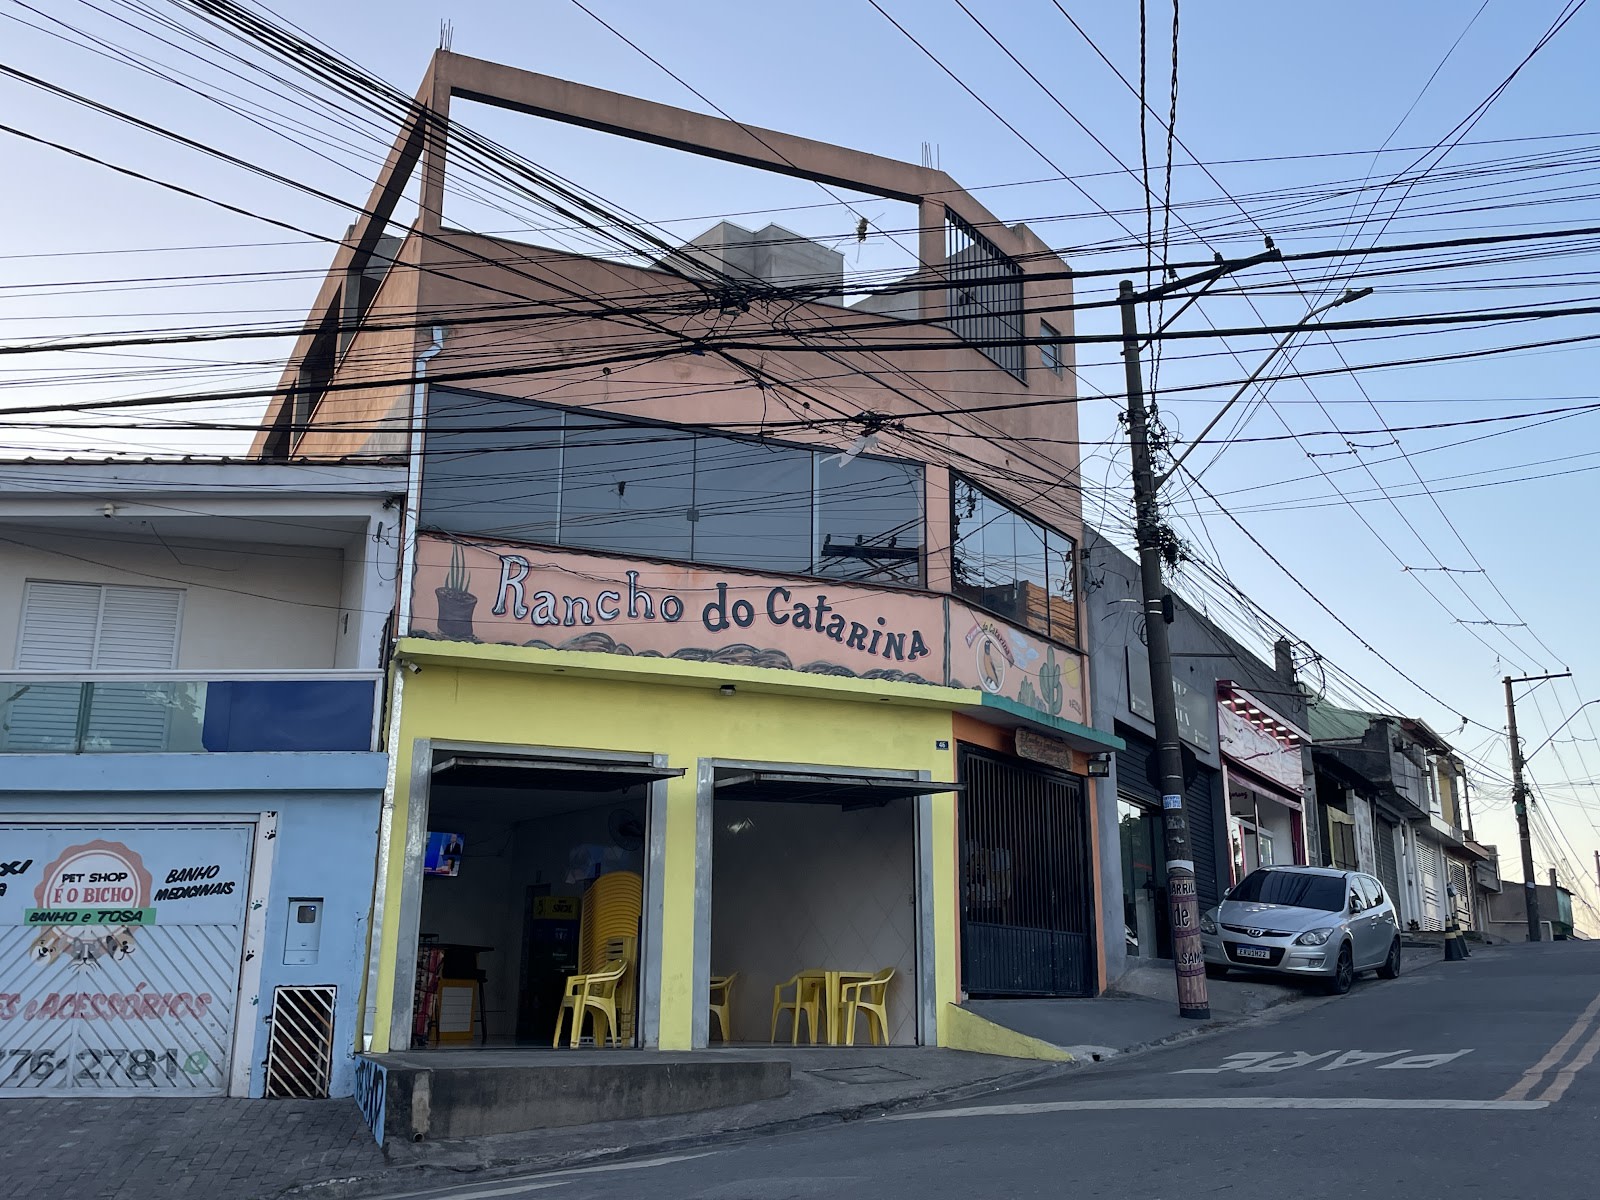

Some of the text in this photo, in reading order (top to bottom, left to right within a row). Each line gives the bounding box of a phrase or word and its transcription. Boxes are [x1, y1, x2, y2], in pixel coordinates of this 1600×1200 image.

[492, 555, 684, 626] Rancho
[702, 583, 754, 632] do
[62, 872, 128, 883] PET SHOP
[165, 865, 220, 884] BANHO
[66, 887, 79, 904] O
[82, 886, 134, 904] BICHO
[154, 881, 236, 902] MEDICINAIS
[1171, 883, 1196, 896] ARRIL
[29, 910, 143, 923] BANHO e TOSA
[1174, 903, 1191, 928] de
[38, 982, 212, 1021] ACESSÓRIOS
[1169, 1049, 1475, 1074] PARE
